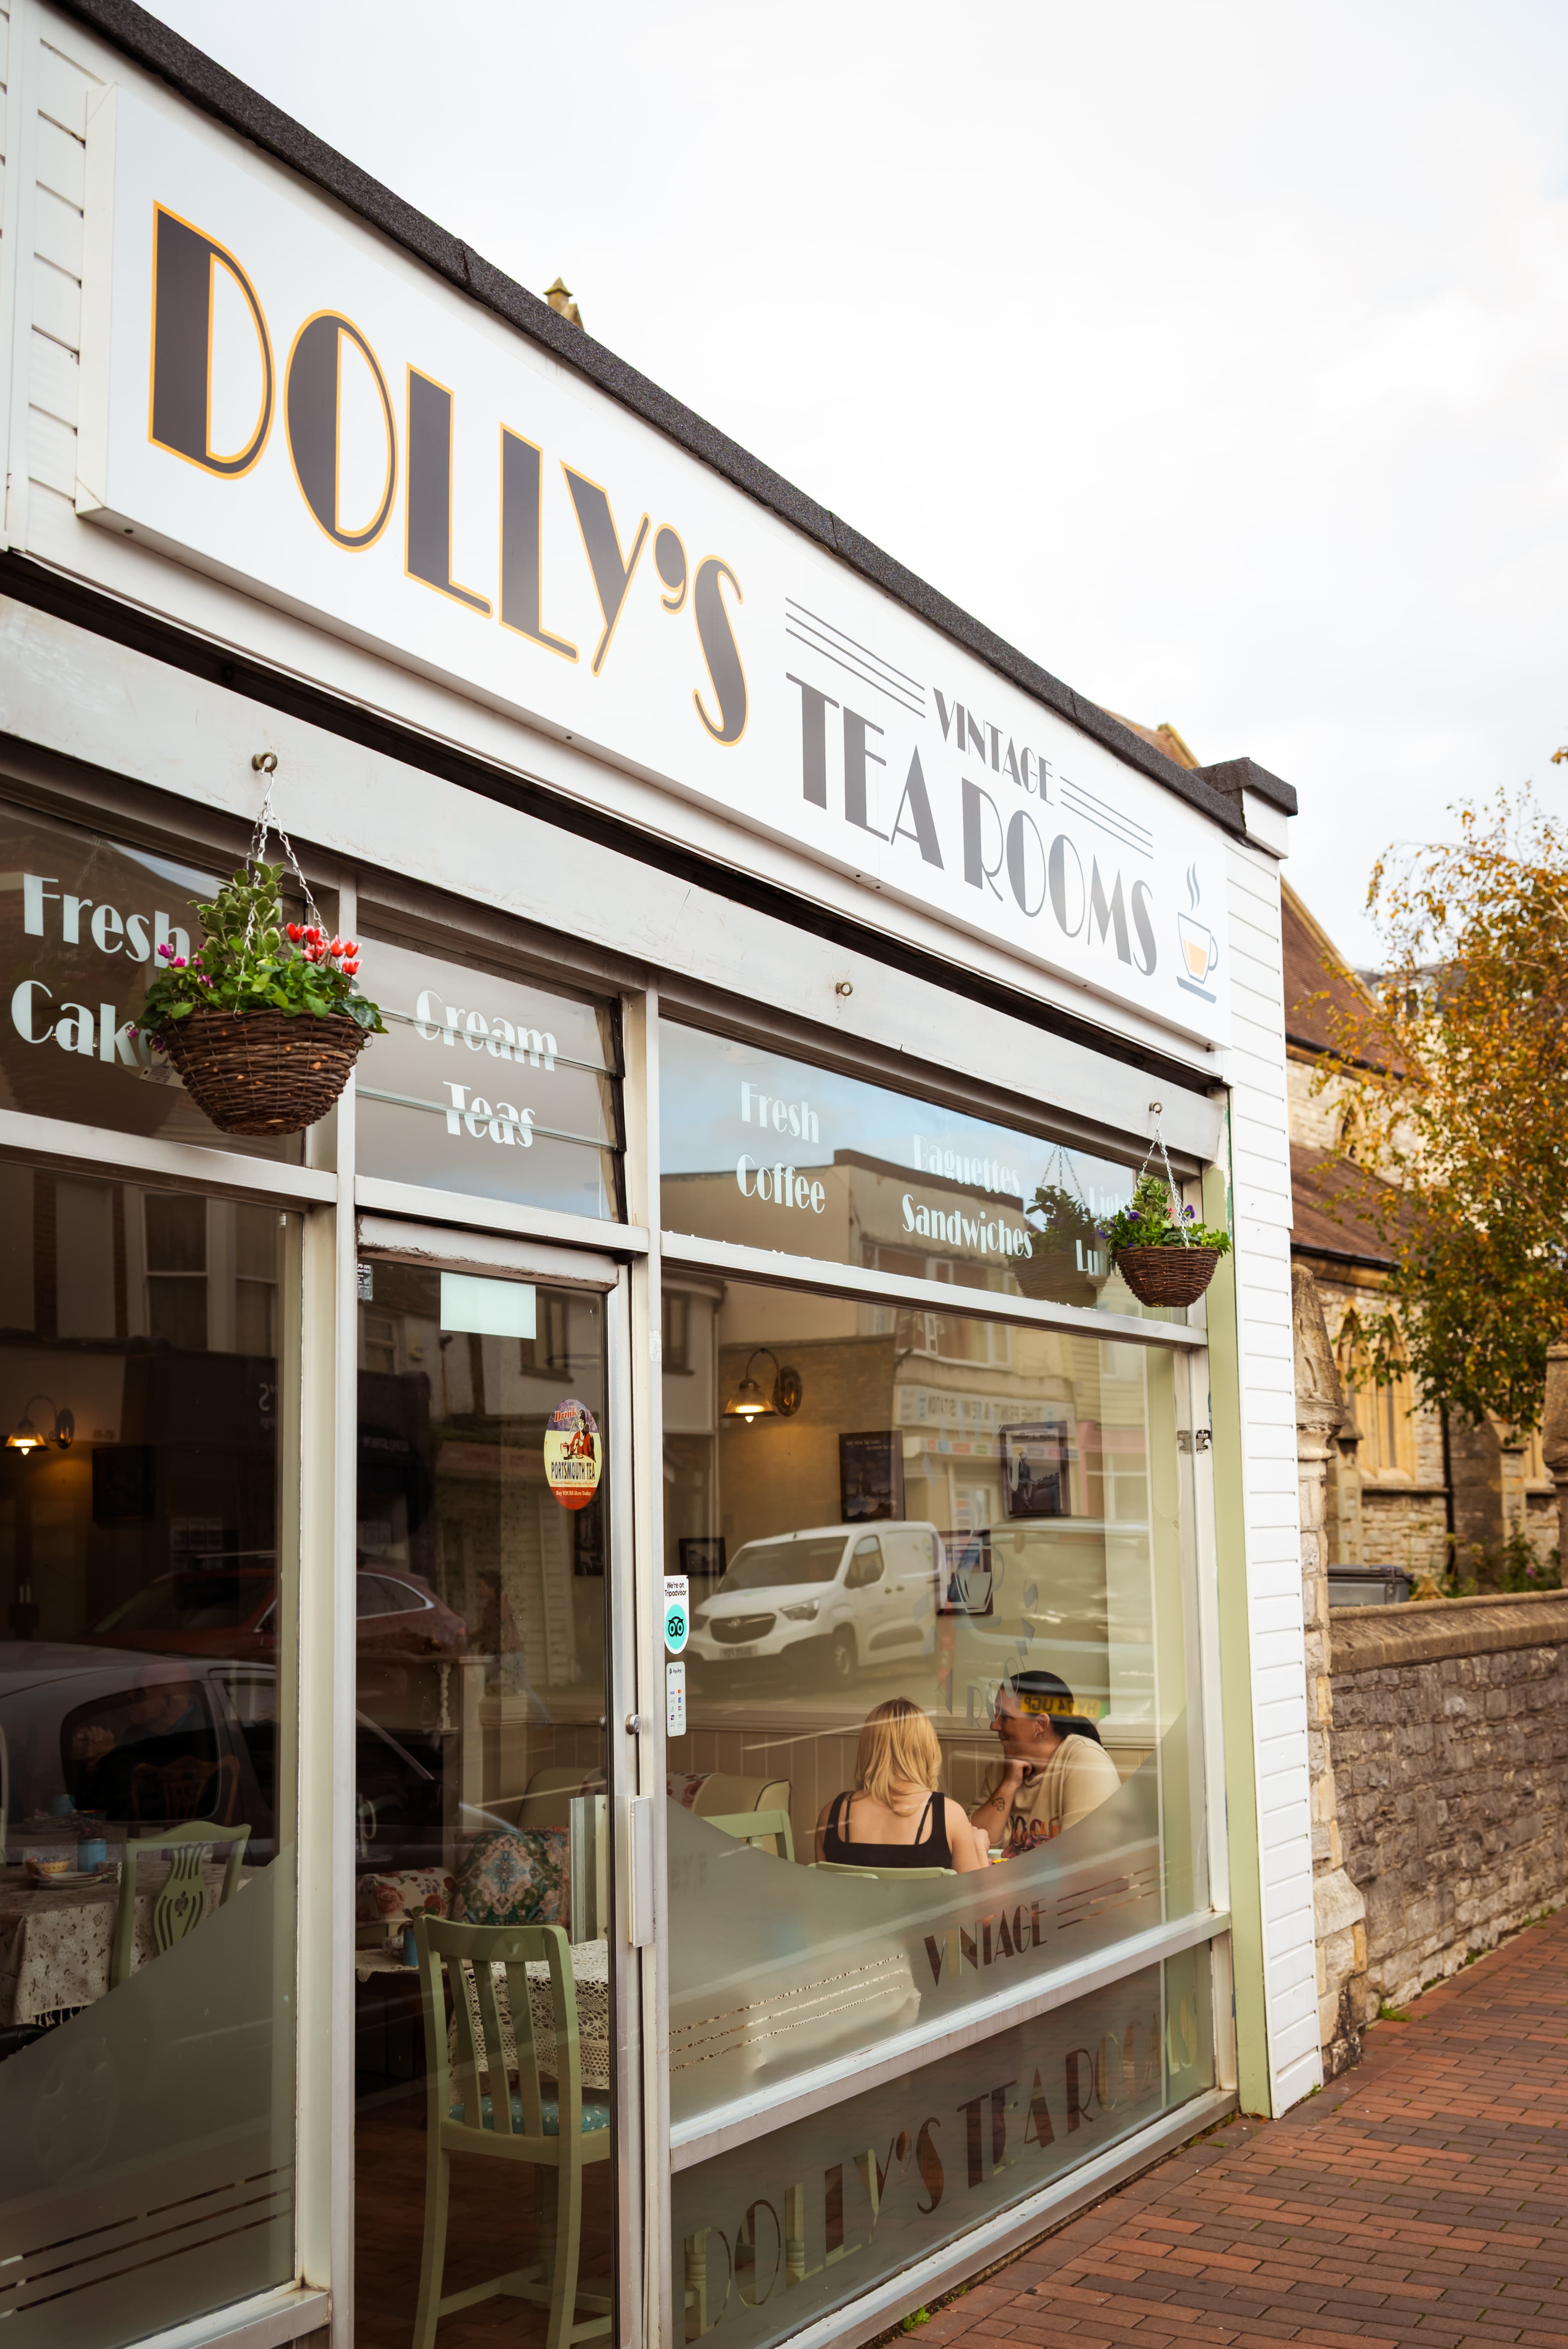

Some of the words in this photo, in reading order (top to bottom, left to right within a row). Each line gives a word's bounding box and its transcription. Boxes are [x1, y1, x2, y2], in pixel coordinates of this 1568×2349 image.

[148, 199, 748, 747] DOLLY'S
[933, 687, 1054, 806] VINTAGE
[786, 672, 945, 870] TEA
[961, 777, 1157, 976] ROOMS
[23, 873, 191, 968] Fresh
[413, 990, 557, 1071] Cream
[443, 1081, 535, 1148] Teas
[741, 1081, 819, 1144] Fresh
[736, 1154, 825, 1213] Coffee
[913, 1133, 1020, 1197] Baguettes
[902, 1194, 1033, 1259] Sandwiches
[554, 1406, 576, 1422] Drink
[551, 1461, 585, 1479] PORTSMOUTH
[587, 1462, 595, 1480] TEA
[665, 1589, 686, 1598] Tripadvisor
[924, 1898, 1048, 1987] VINTAGE
[685, 2117, 944, 2345] DOLLY'S
[957, 2066, 1055, 2189] TEA
